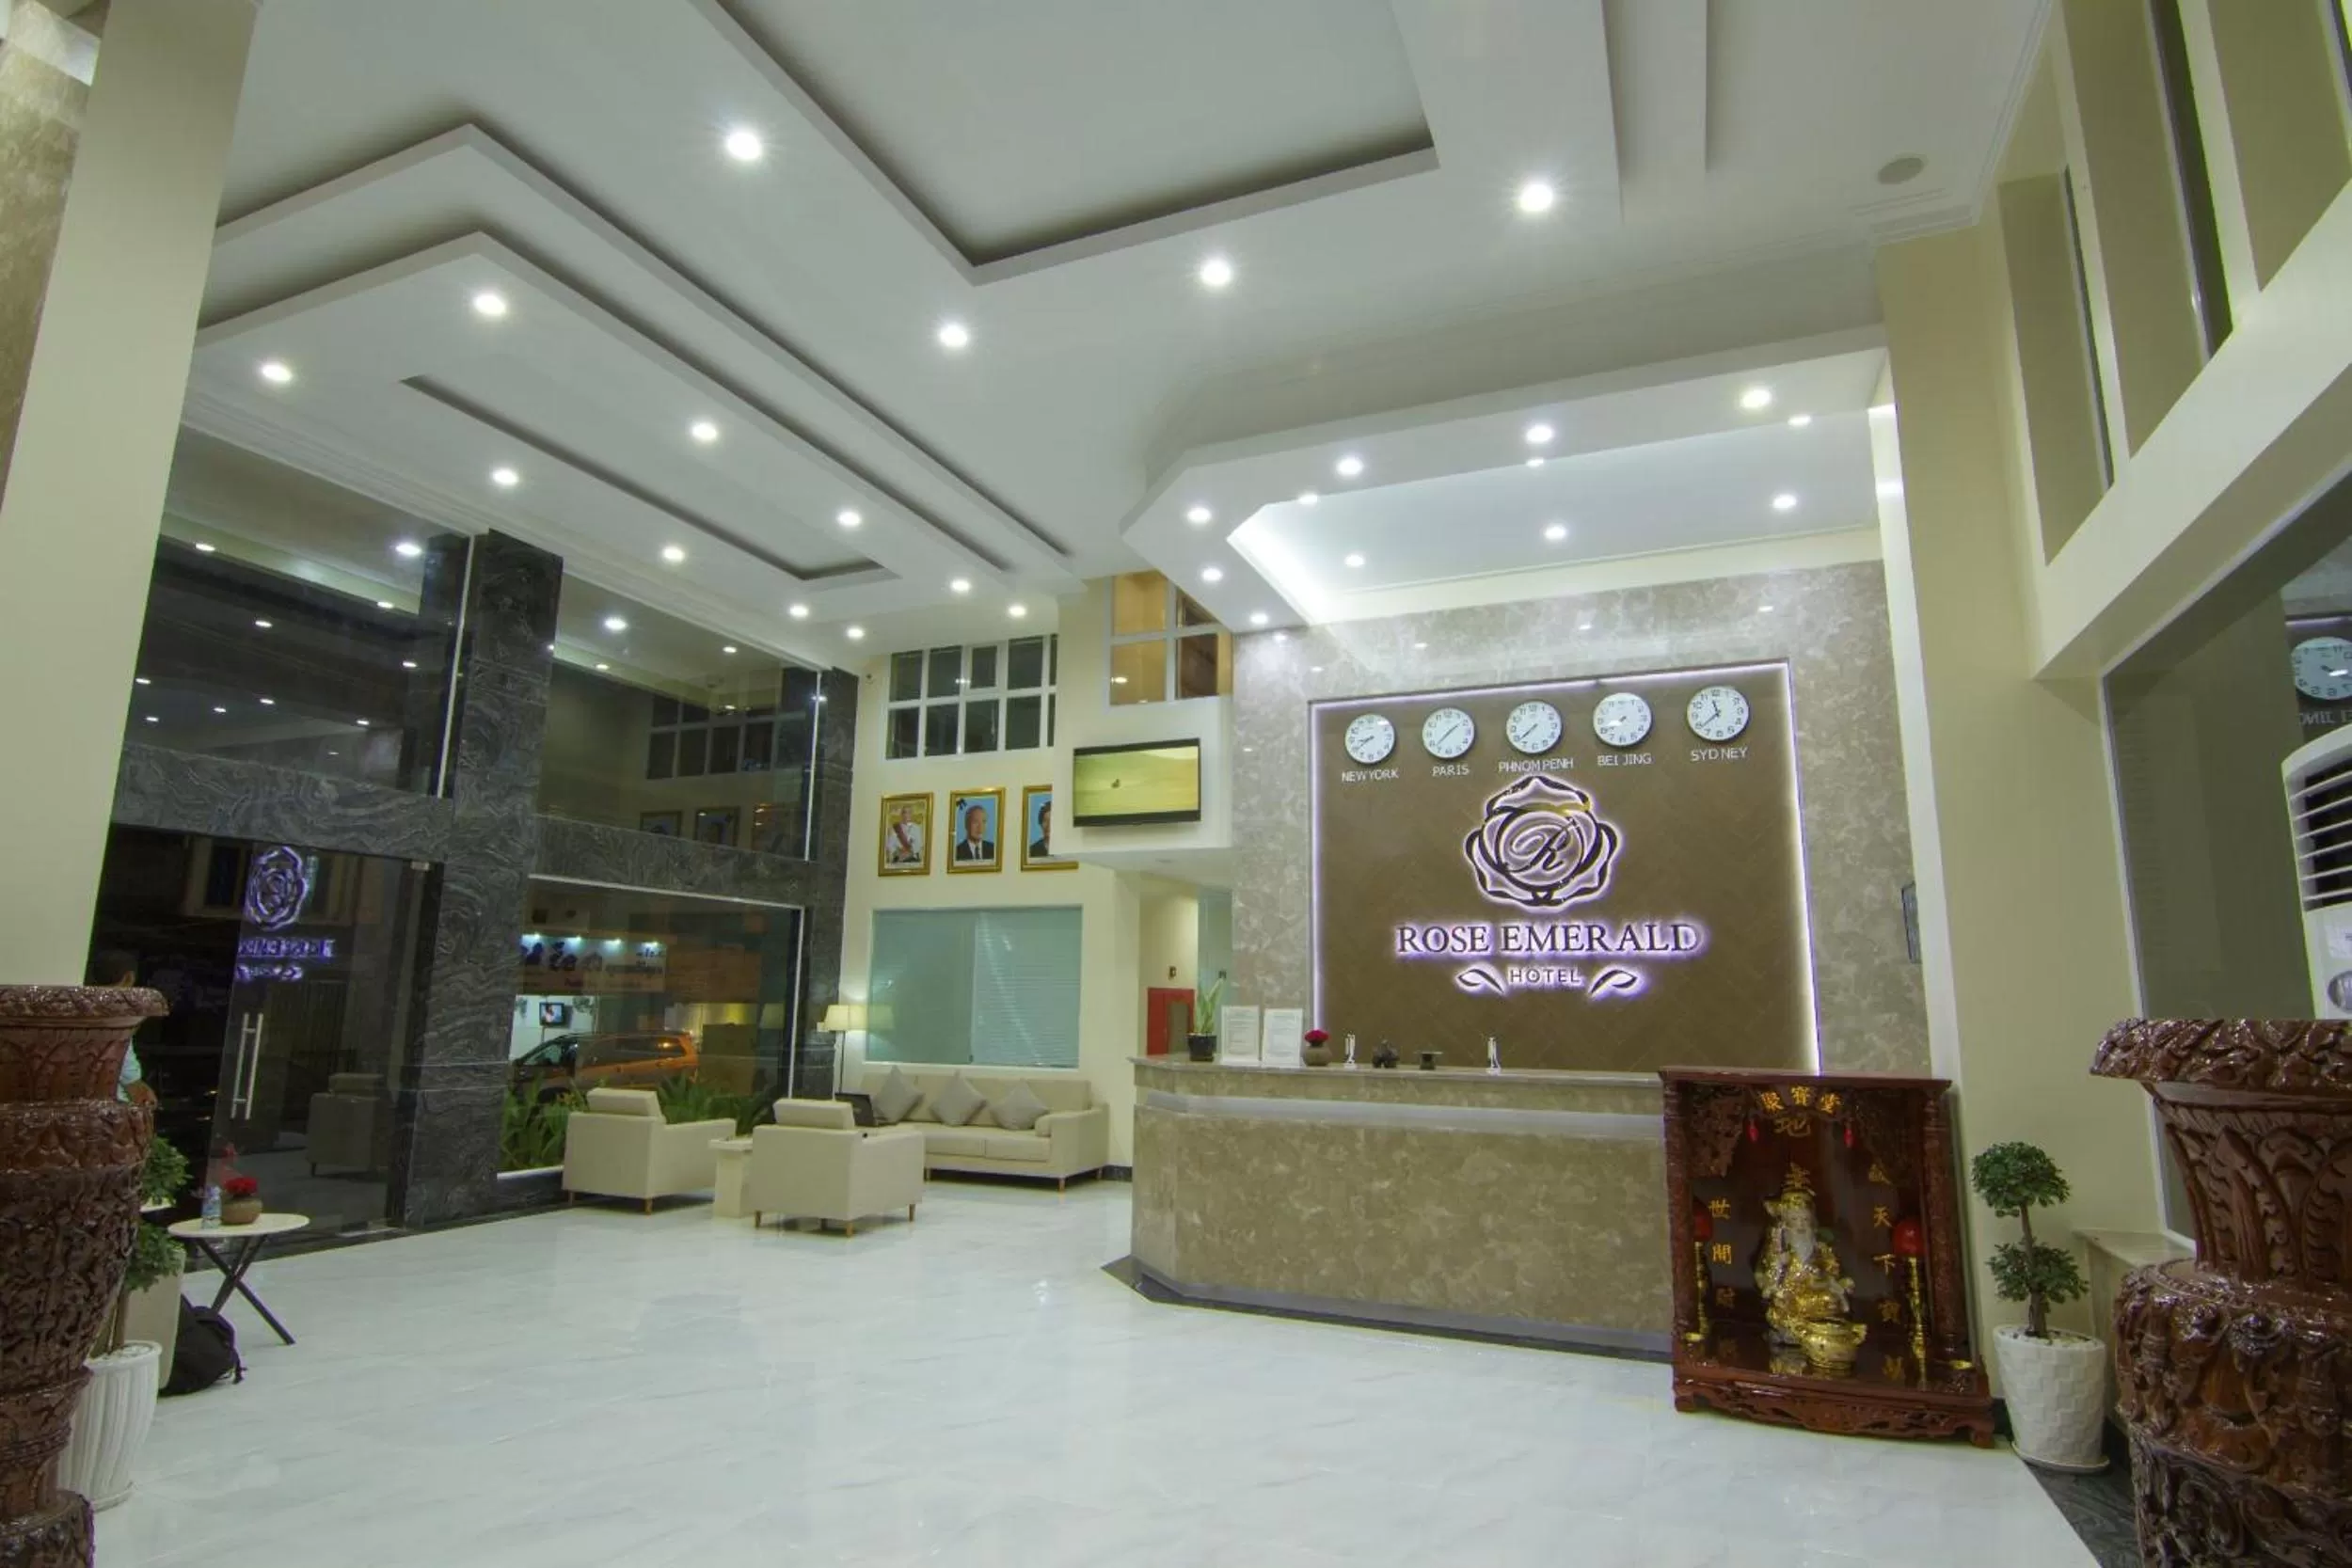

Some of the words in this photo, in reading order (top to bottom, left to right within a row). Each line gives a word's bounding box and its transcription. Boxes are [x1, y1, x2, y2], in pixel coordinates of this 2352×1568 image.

[1690, 747, 1748, 762] SYDNEY
[1432, 764, 1470, 777] PARIS
[1397, 925, 1490, 954] ROSE
[1500, 922, 1697, 953] EMERALD
[1510, 968, 1582, 984] HOTEL
